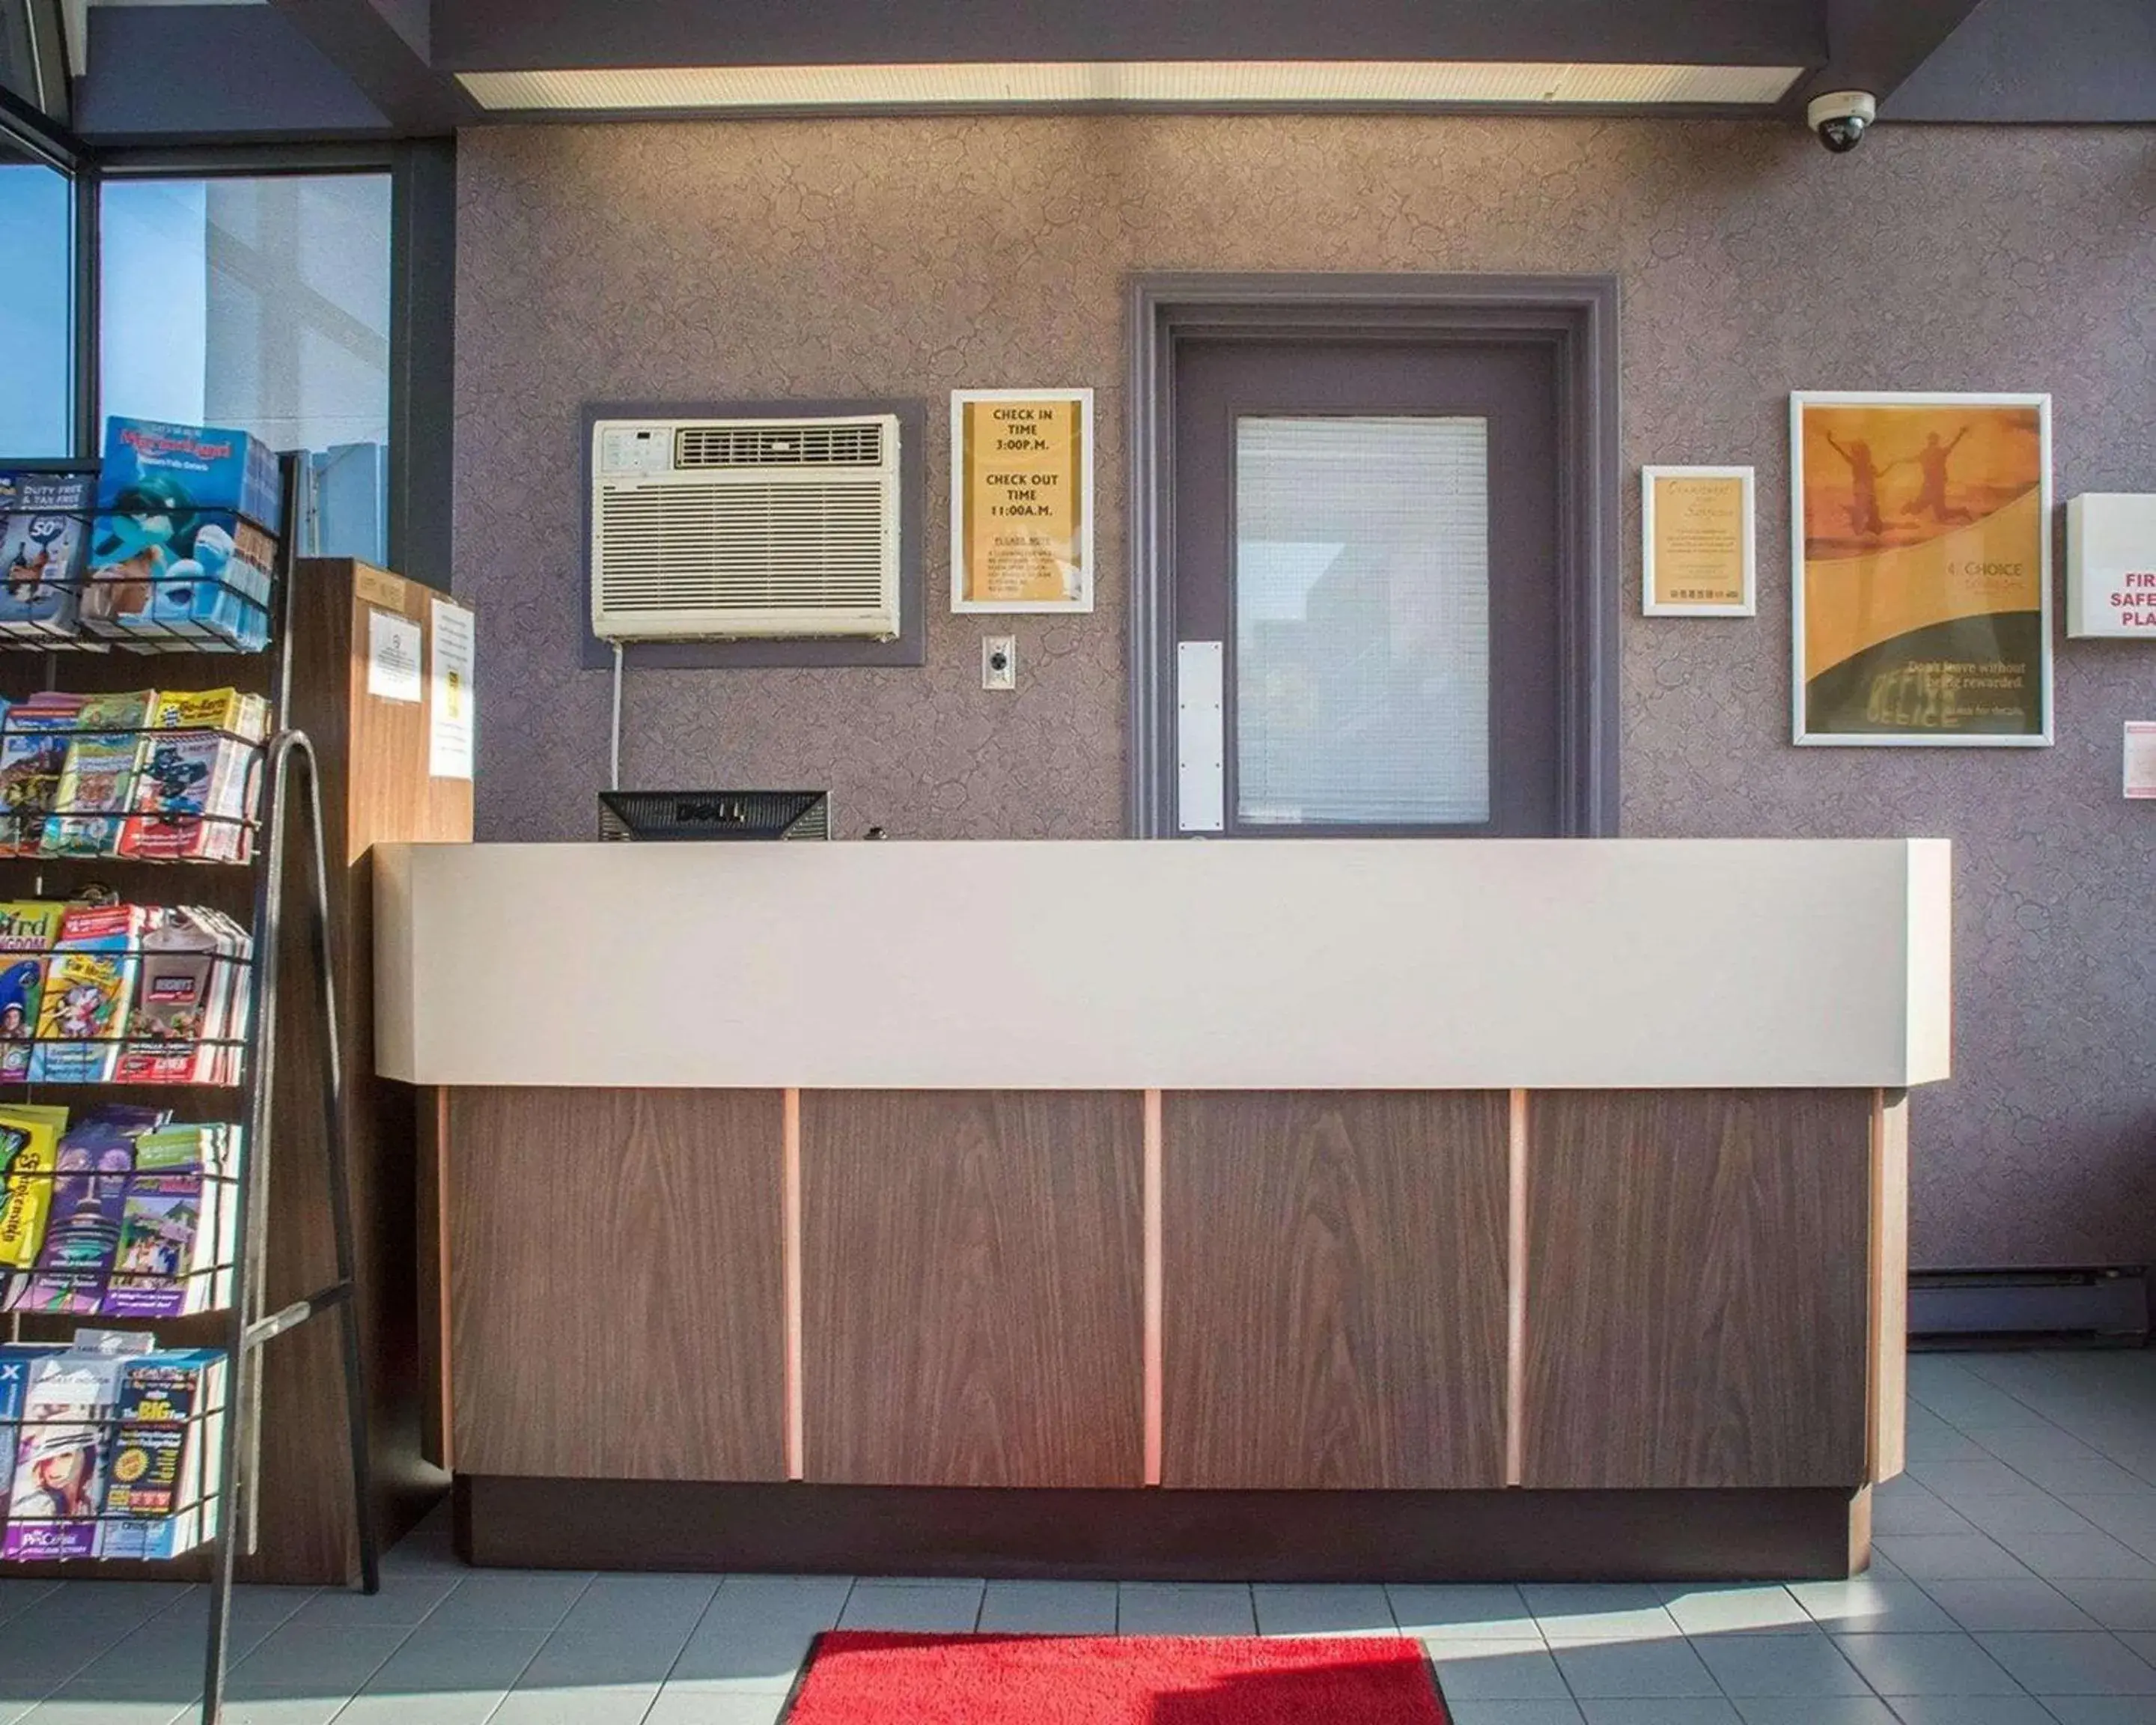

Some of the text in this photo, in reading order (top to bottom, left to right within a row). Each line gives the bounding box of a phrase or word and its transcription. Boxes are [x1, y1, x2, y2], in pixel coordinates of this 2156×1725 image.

[993, 410, 1052, 419] CHECK IN
[1008, 425, 1037, 435] TIME
[997, 439, 1049, 450] 3:00P.M.
[986, 474, 1059, 485] CHECK OUT
[1007, 490, 1036, 500] TIME
[1979, 662, 2026, 674] without
[138, 1401, 171, 1420] BIG
